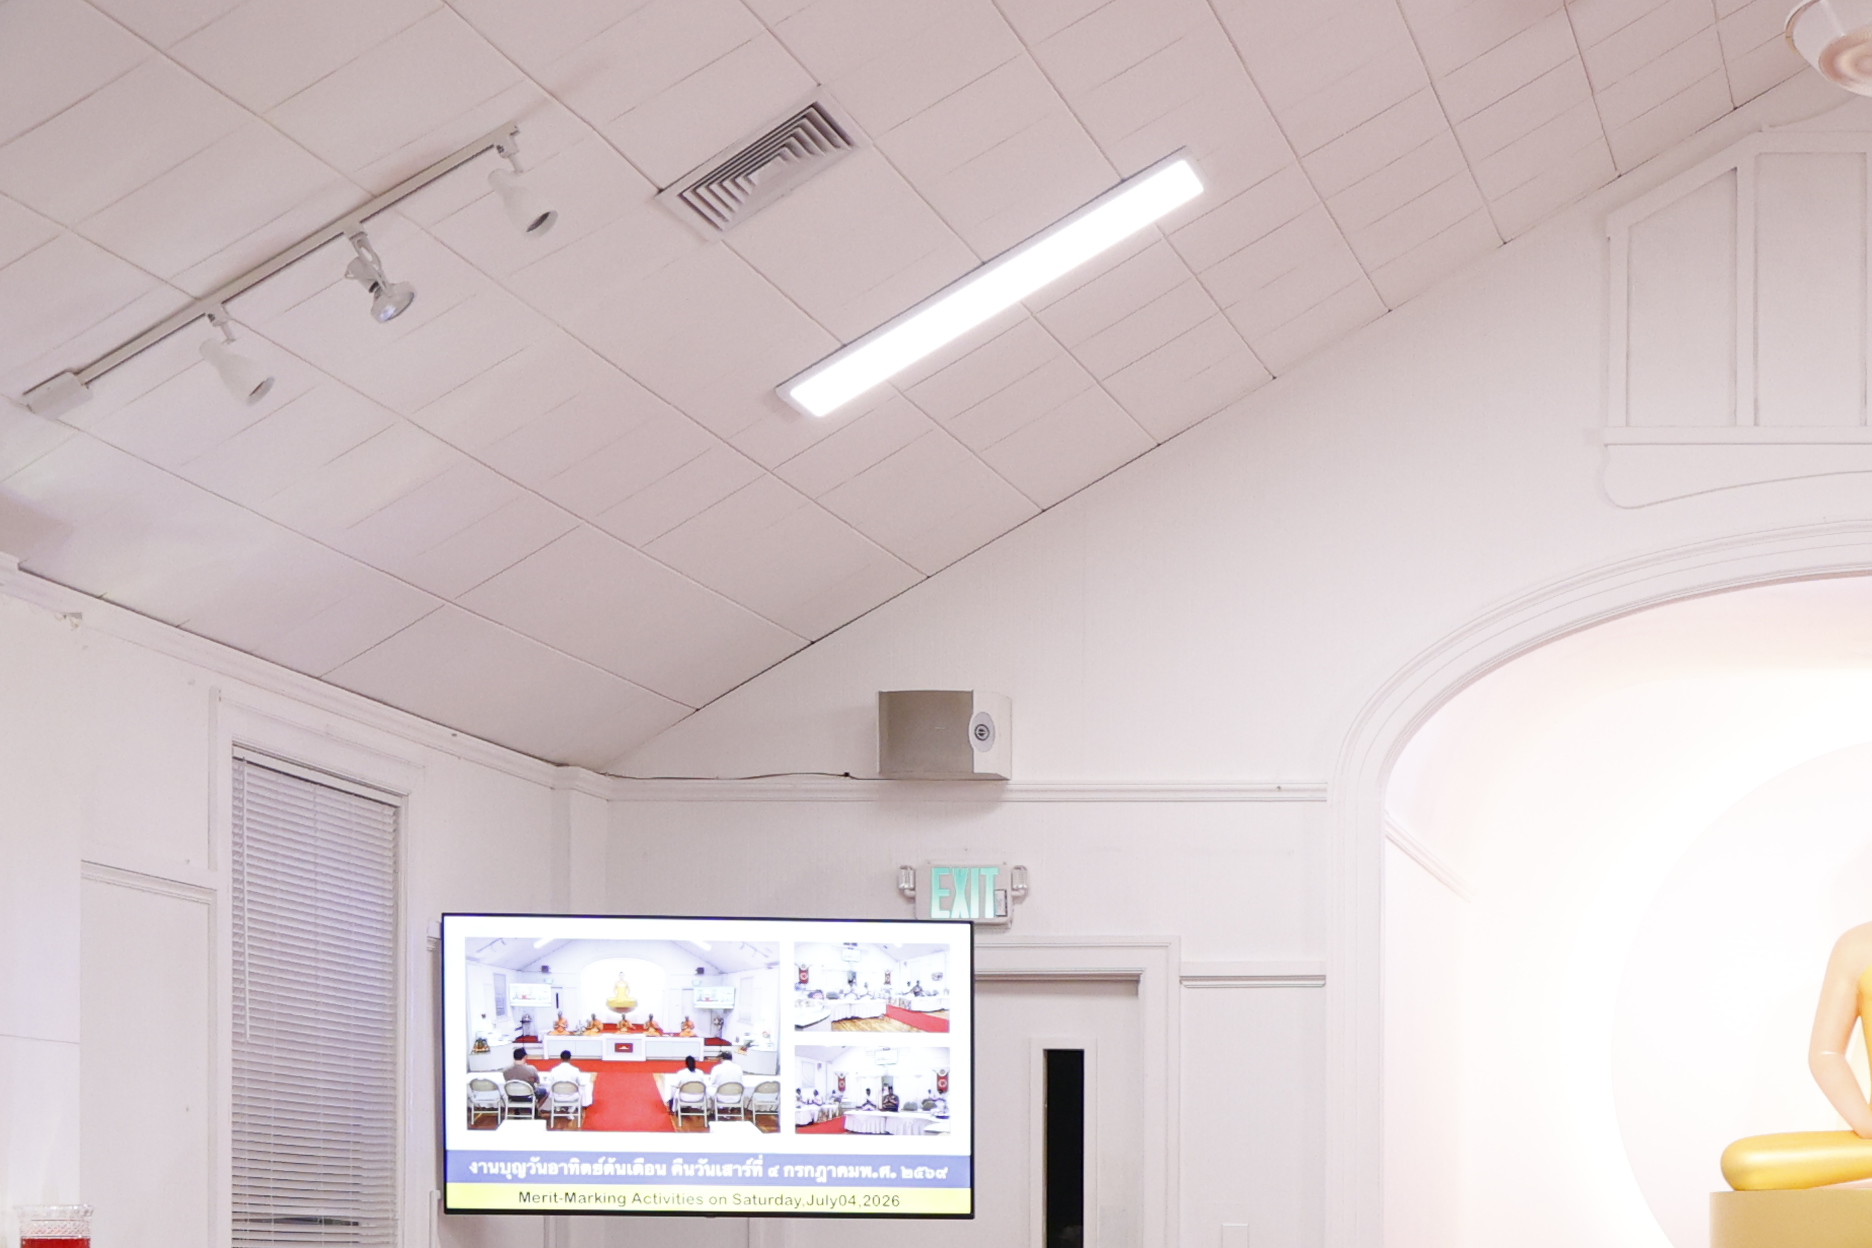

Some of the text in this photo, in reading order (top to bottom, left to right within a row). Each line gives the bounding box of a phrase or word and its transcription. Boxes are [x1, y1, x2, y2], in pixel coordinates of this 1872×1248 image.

[930, 866, 1000, 919] EXIT
[518, 1190, 627, 1207] Merit-Marking
[631, 1192, 704, 1206] Activities
[708, 1195, 728, 1206] on
